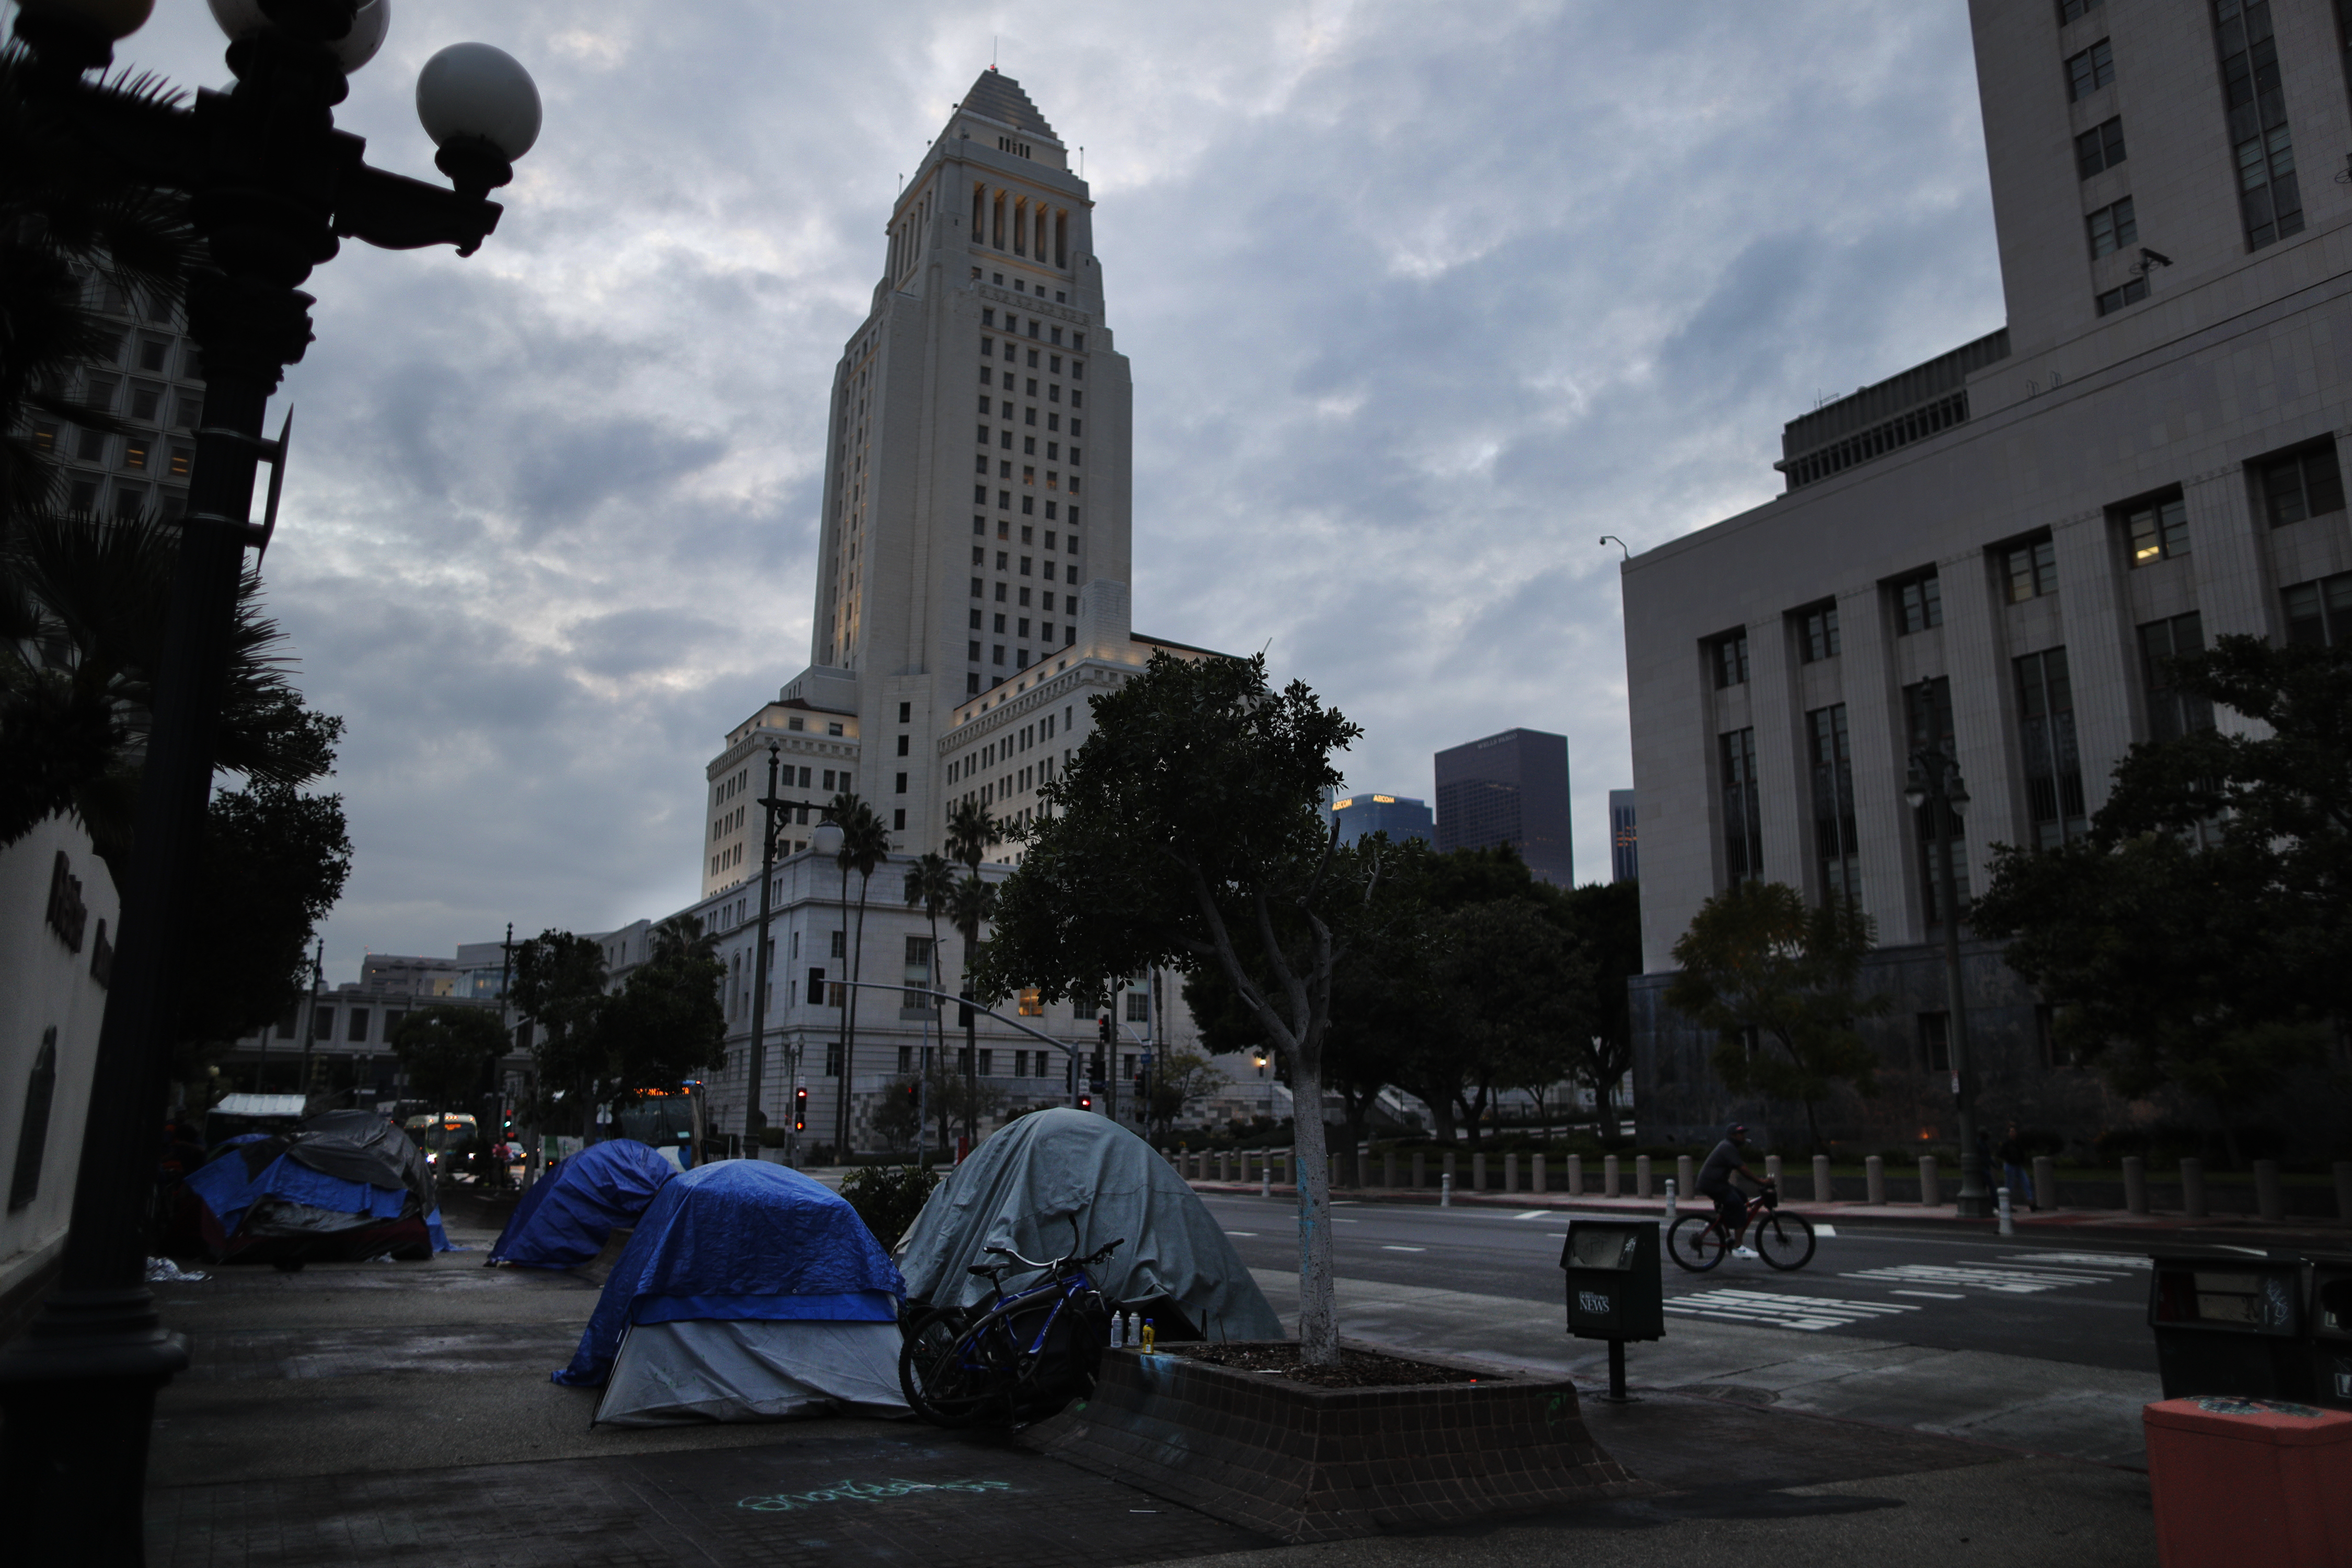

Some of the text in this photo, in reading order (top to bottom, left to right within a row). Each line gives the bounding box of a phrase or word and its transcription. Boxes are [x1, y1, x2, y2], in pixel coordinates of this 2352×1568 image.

[1332, 798, 1353, 811] AECOM
[1373, 795, 1395, 803] AECOM
[1579, 1298, 1610, 1312] NEWS
